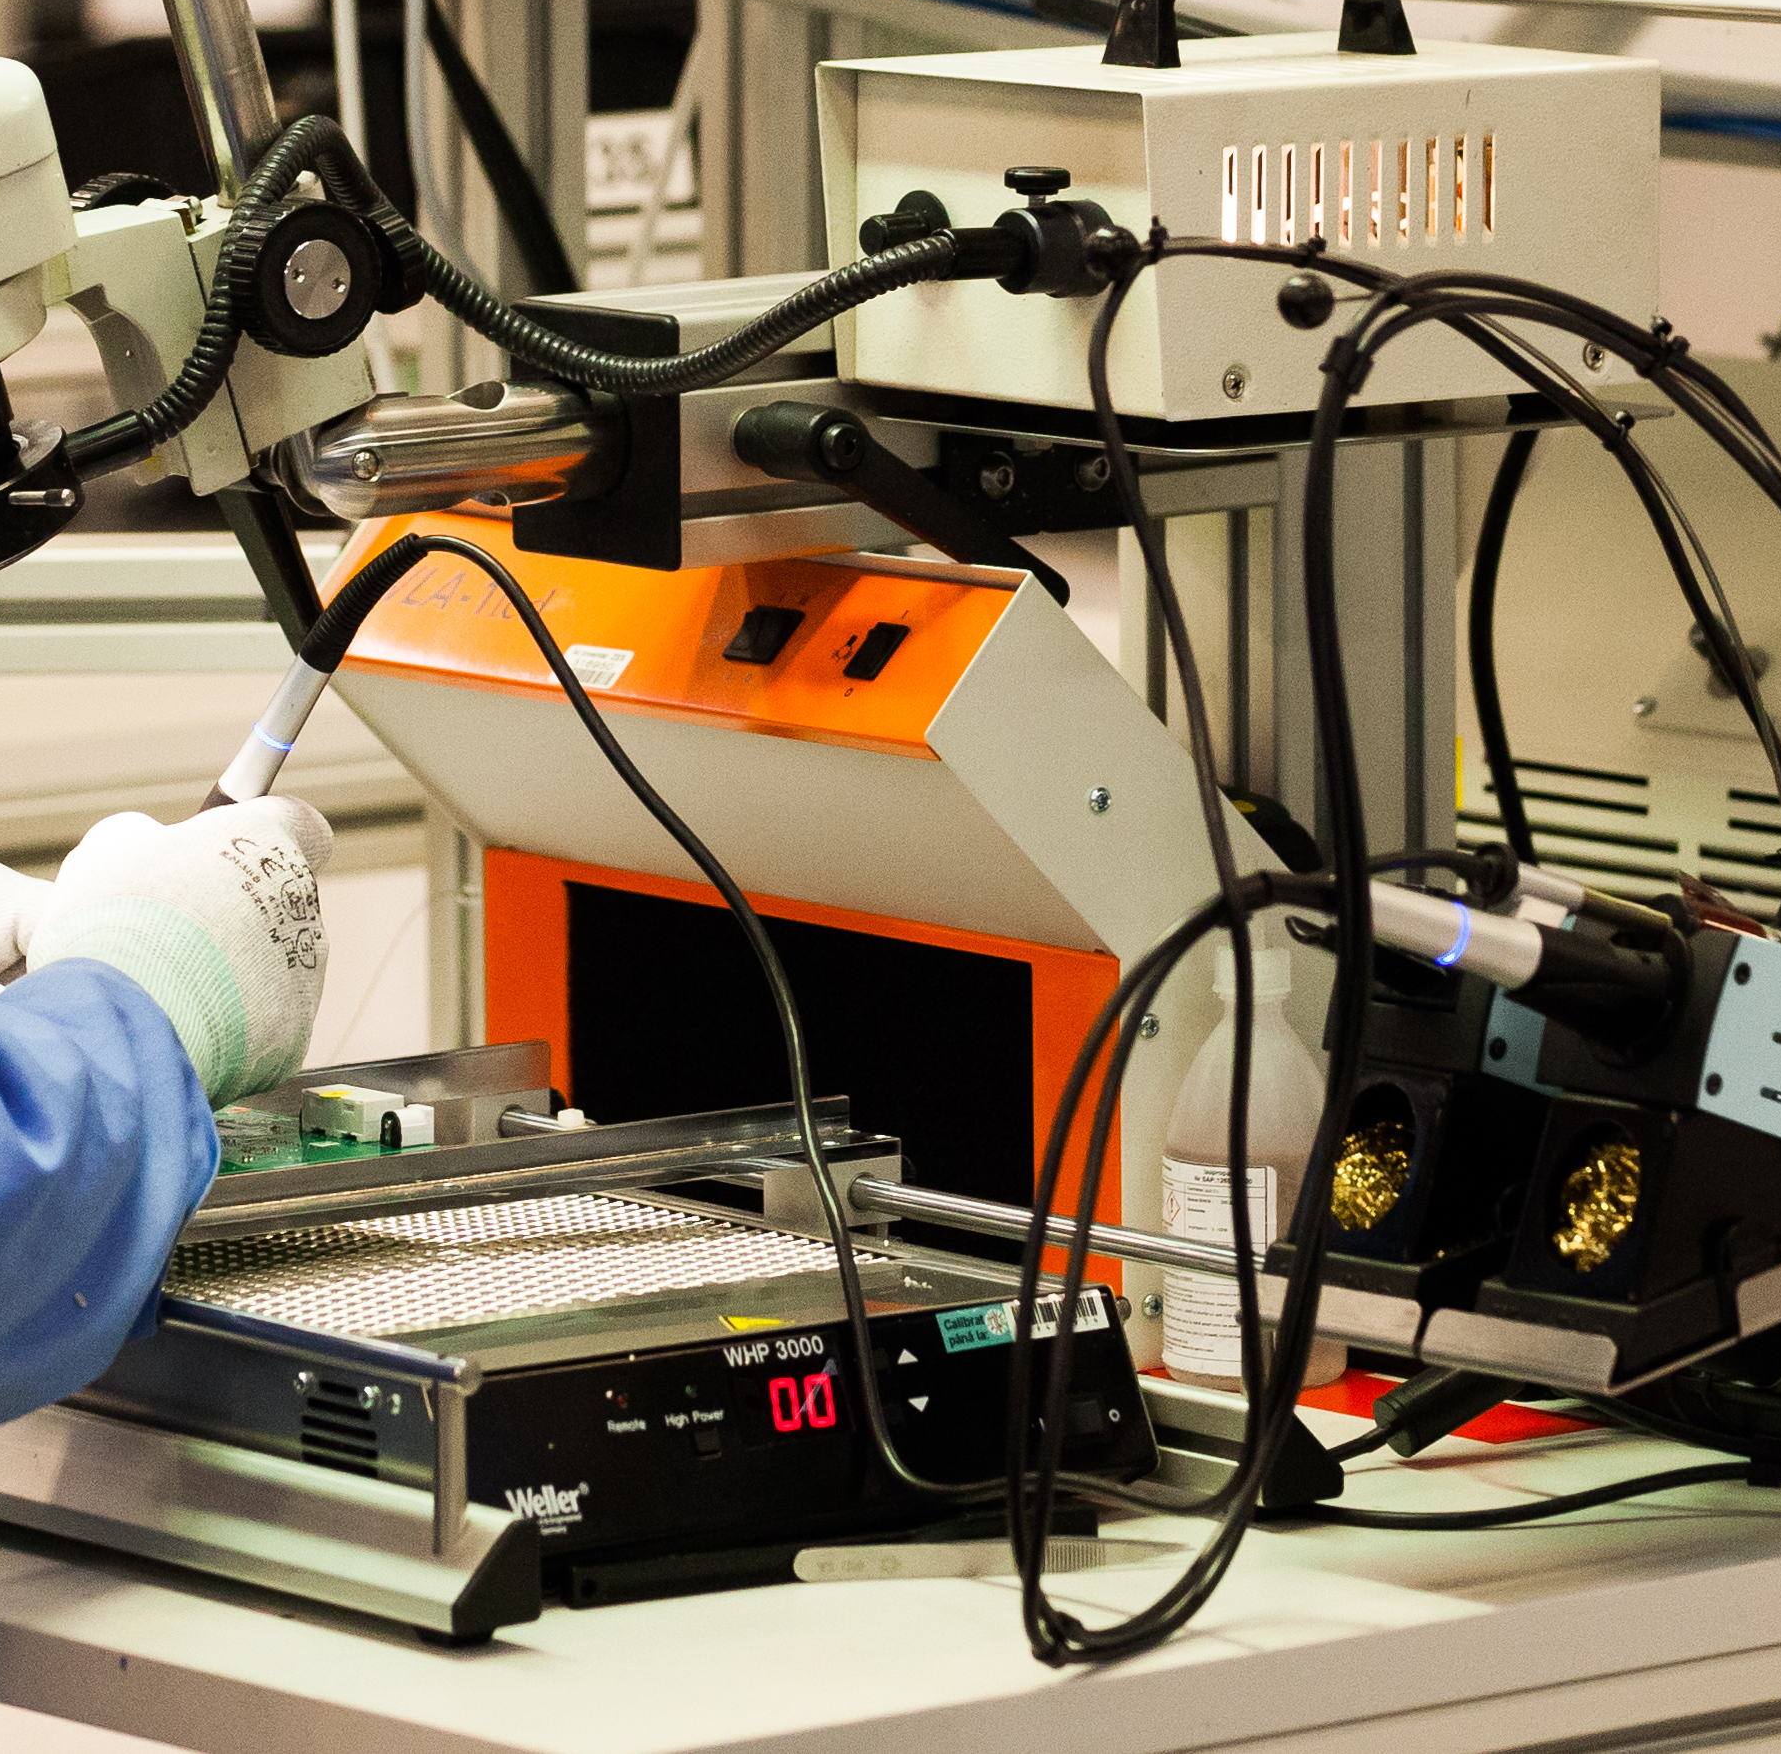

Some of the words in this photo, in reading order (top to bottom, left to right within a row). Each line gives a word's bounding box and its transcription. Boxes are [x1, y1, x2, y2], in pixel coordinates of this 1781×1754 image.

[723, 1344, 770, 1368] WHP
[775, 1335, 824, 1360] 3000
[607, 1418, 647, 1433] Remote
[664, 1413, 689, 1429] High
[692, 1408, 724, 1423] Power
